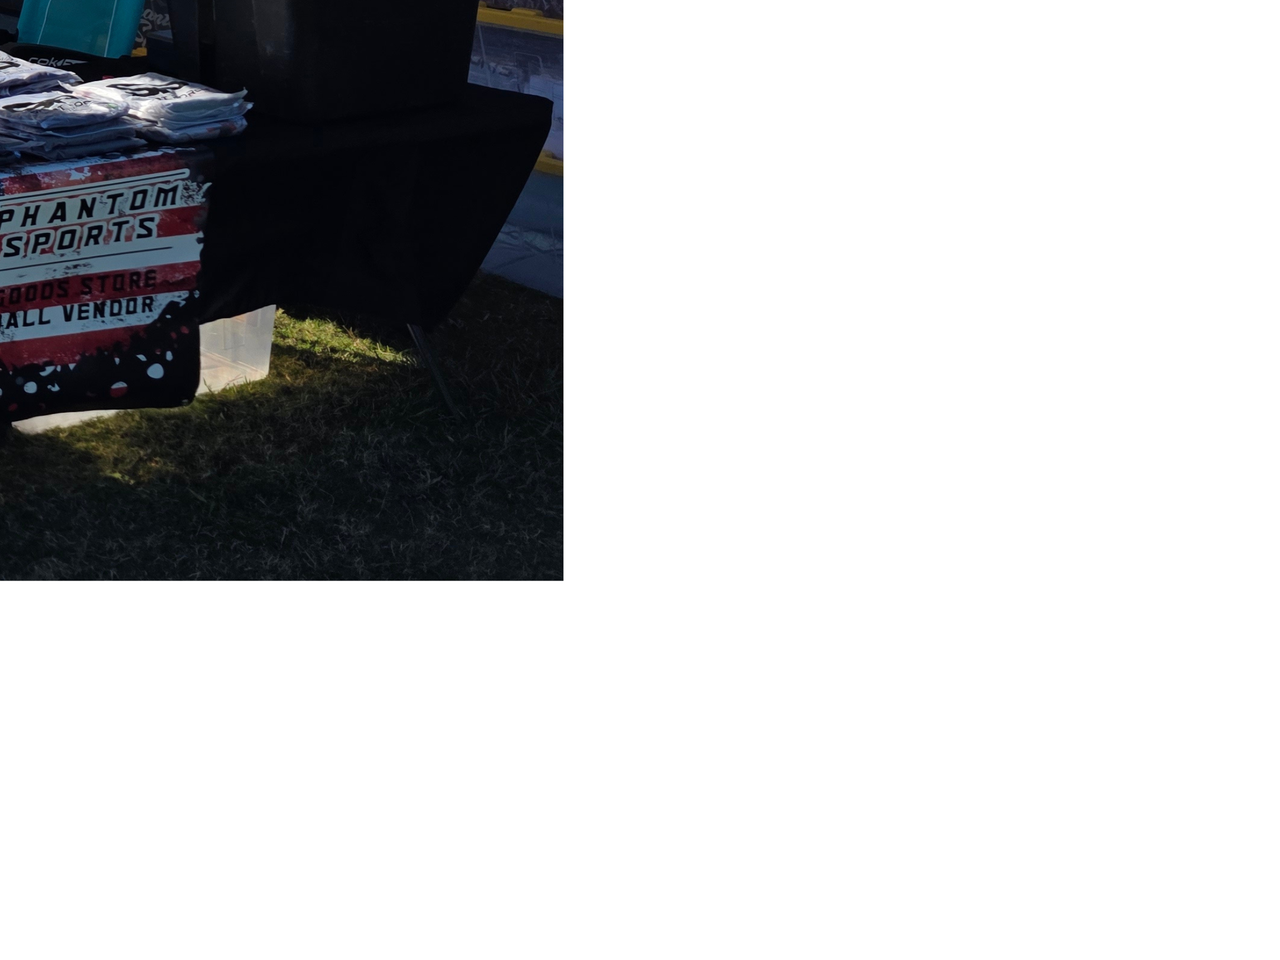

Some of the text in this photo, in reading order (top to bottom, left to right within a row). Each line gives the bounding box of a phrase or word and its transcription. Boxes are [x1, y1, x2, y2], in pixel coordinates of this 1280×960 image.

[3, 217, 155, 257] SPORTS
[80, 269, 157, 295] STORE
[63, 296, 154, 322] VENDOR
